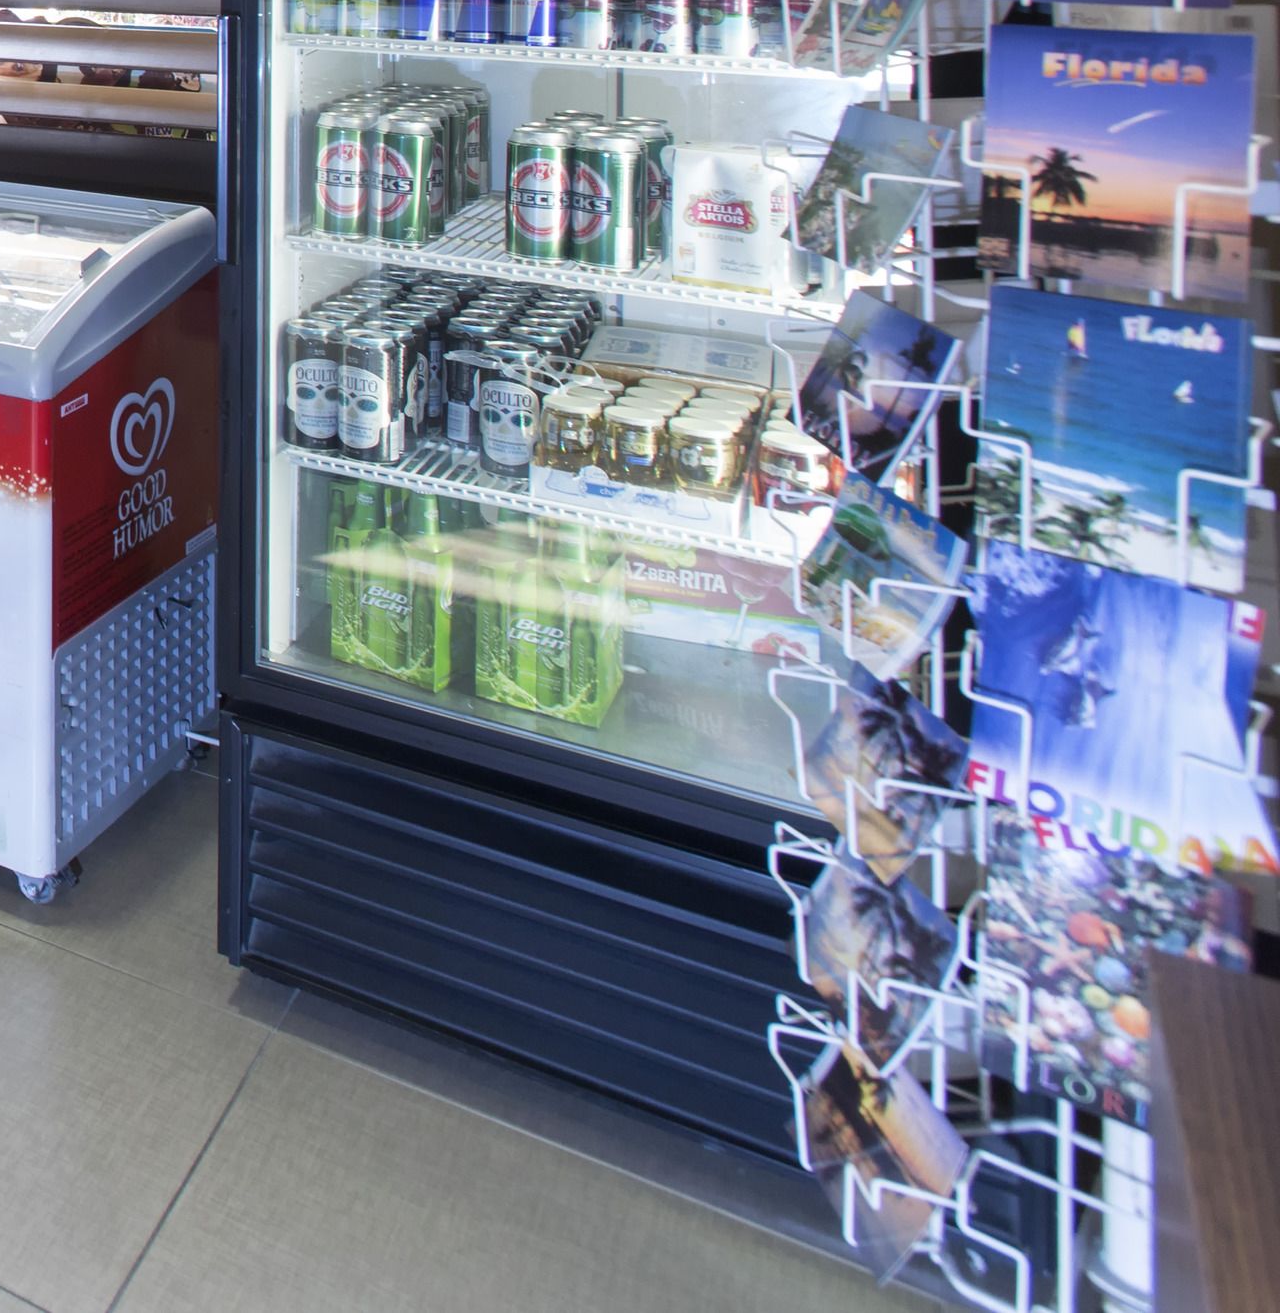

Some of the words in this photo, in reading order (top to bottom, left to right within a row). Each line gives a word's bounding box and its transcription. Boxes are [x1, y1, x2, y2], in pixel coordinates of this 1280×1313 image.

[1041, 52, 1207, 86] Florida
[697, 203, 744, 217] STELLA
[697, 213, 745, 225] ARTOIS
[482, 387, 533, 407] OCULTO
[118, 469, 166, 521] GOOD
[113, 496, 175, 560] HUMOR
[623, 561, 728, 595] AZ-BER-RITA
[367, 586, 407, 604] BUD
[361, 596, 412, 615] LIGHT
[516, 619, 563, 638] BUD
[509, 629, 570, 650] LIGHT
[966, 760, 1212, 875] FLORIDA
